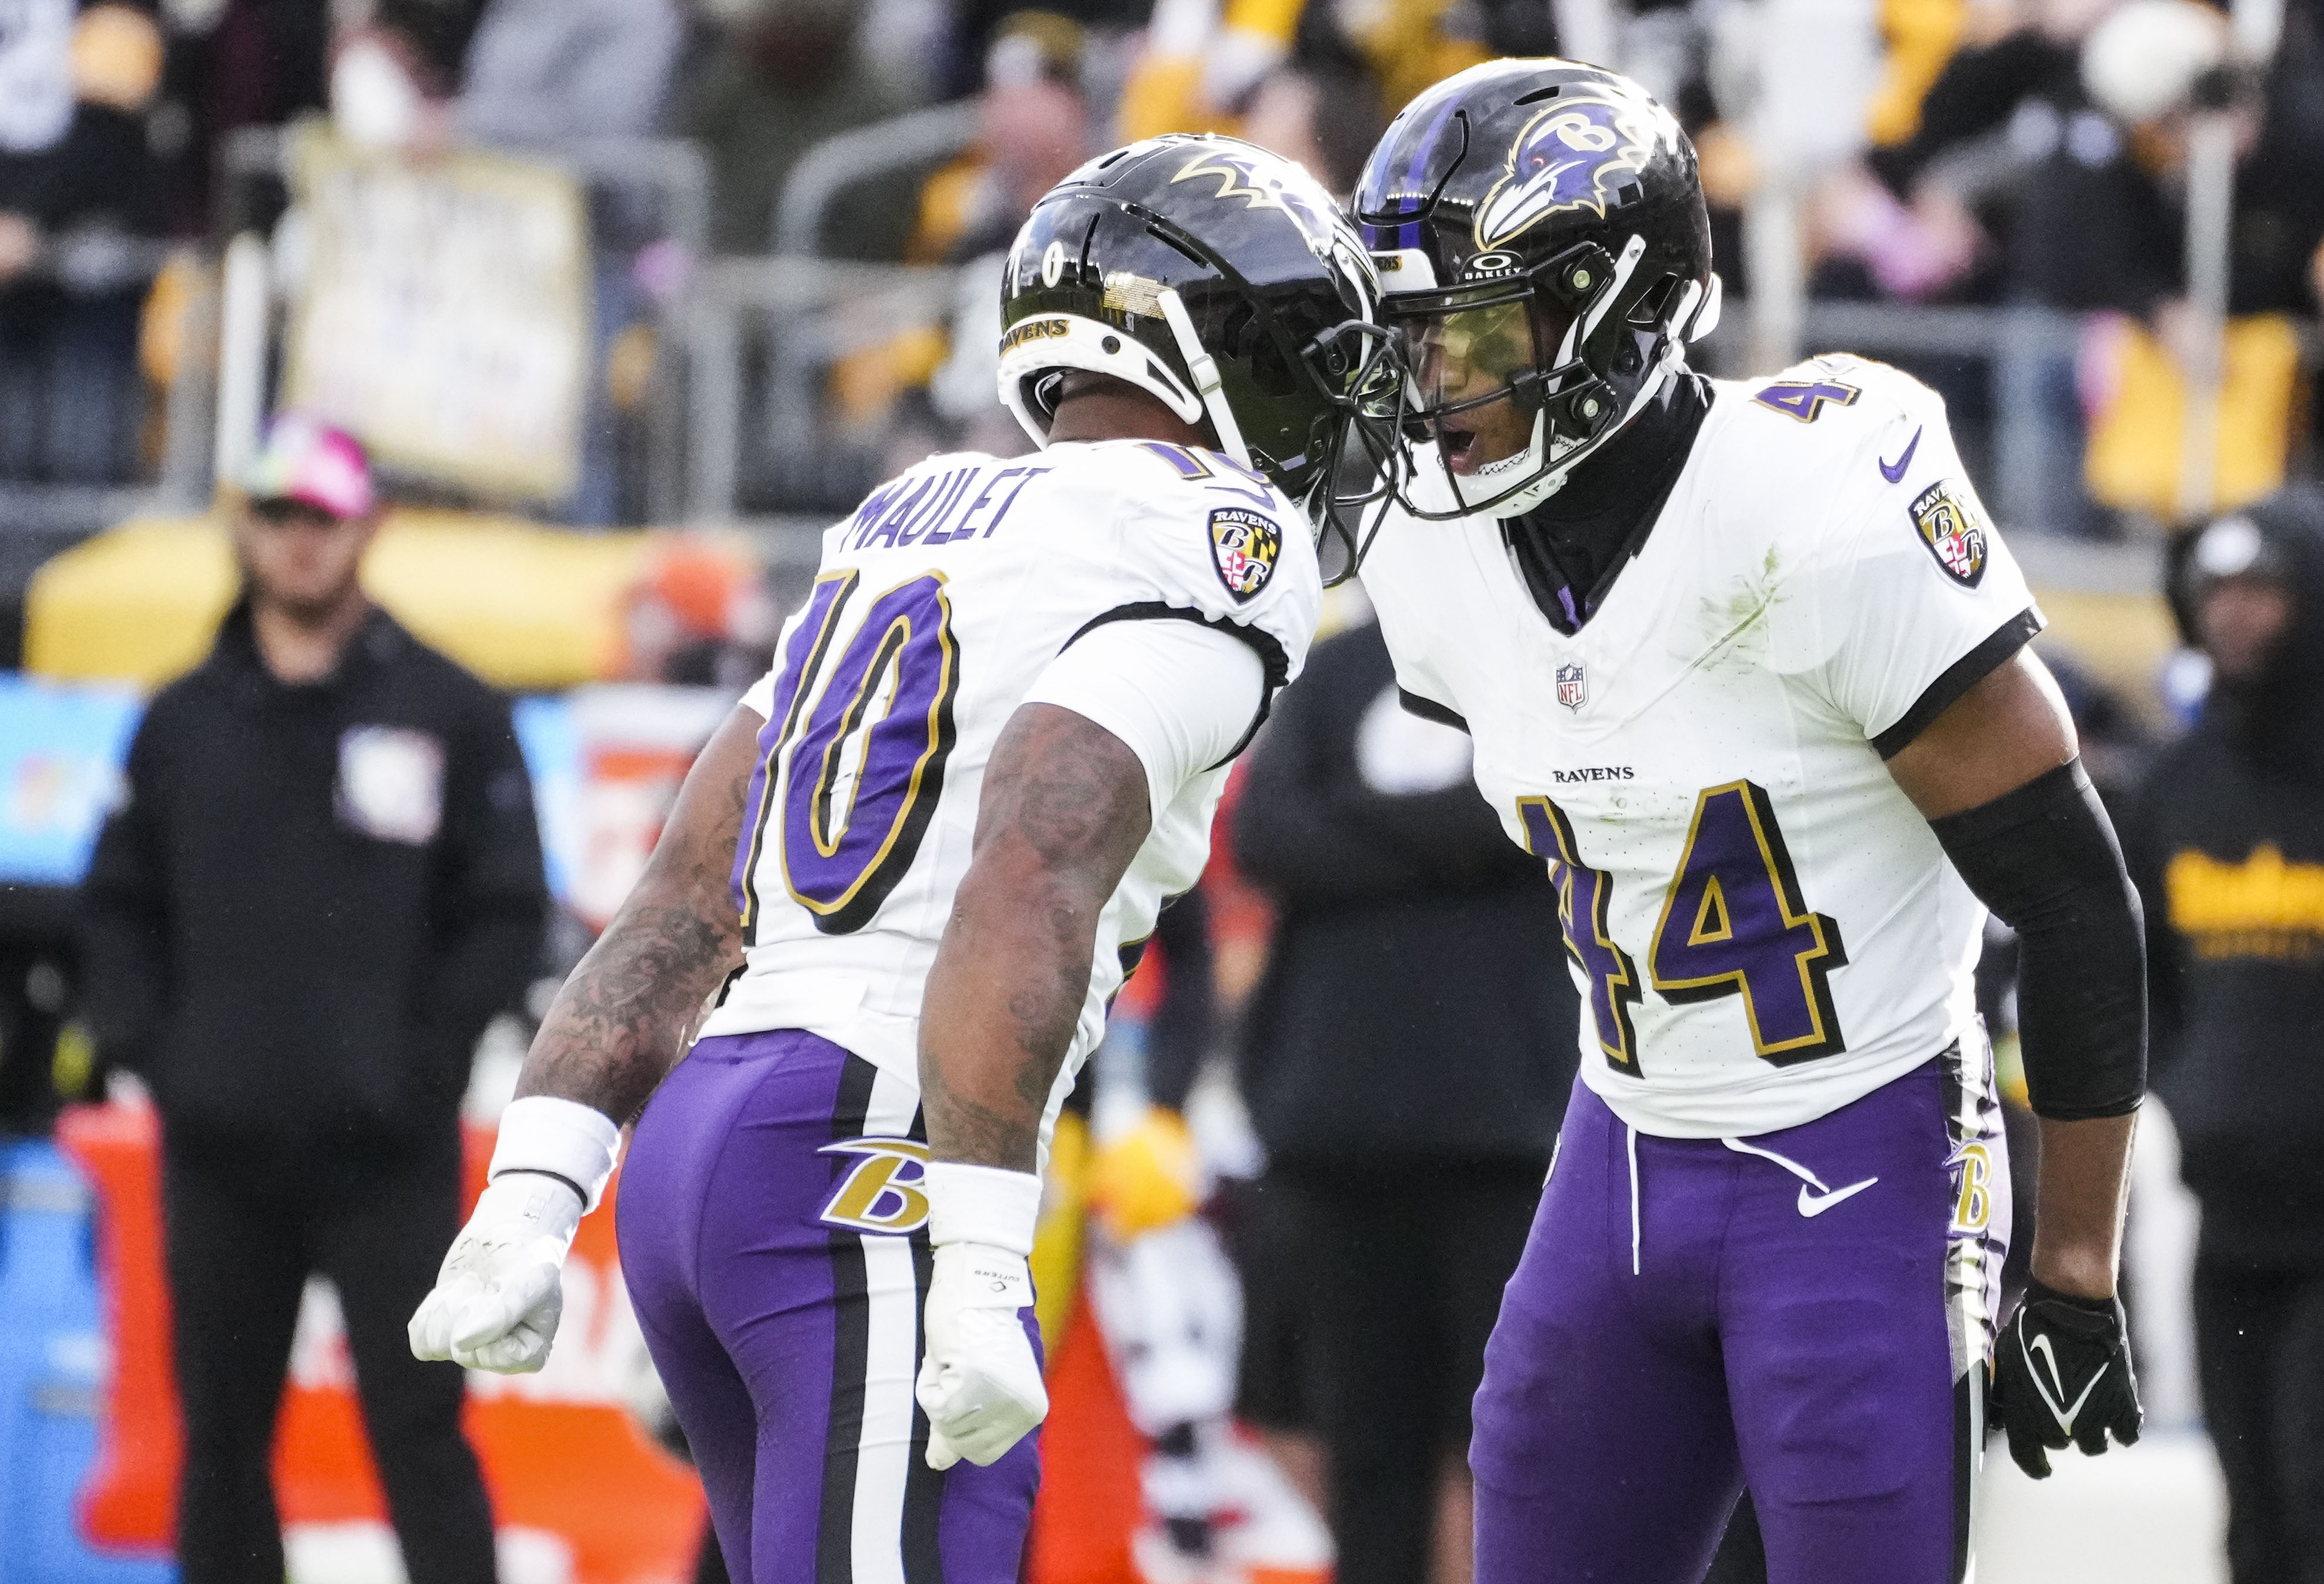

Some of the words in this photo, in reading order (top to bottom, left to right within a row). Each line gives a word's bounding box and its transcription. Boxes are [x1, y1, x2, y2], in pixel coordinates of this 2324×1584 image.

[1465, 267, 1521, 280] OAKLEY
[999, 319, 1071, 358] AVENS
[839, 466, 1056, 553] MAULET
[1214, 511, 1277, 535] RAVENS
[1559, 683, 1582, 703] NFL
[730, 568, 961, 947] 10
[1552, 767, 1634, 783] RAVENS
[1516, 777, 1849, 1080] 44
[817, 1137, 930, 1233] B
[1944, 1142, 1992, 1234] B
